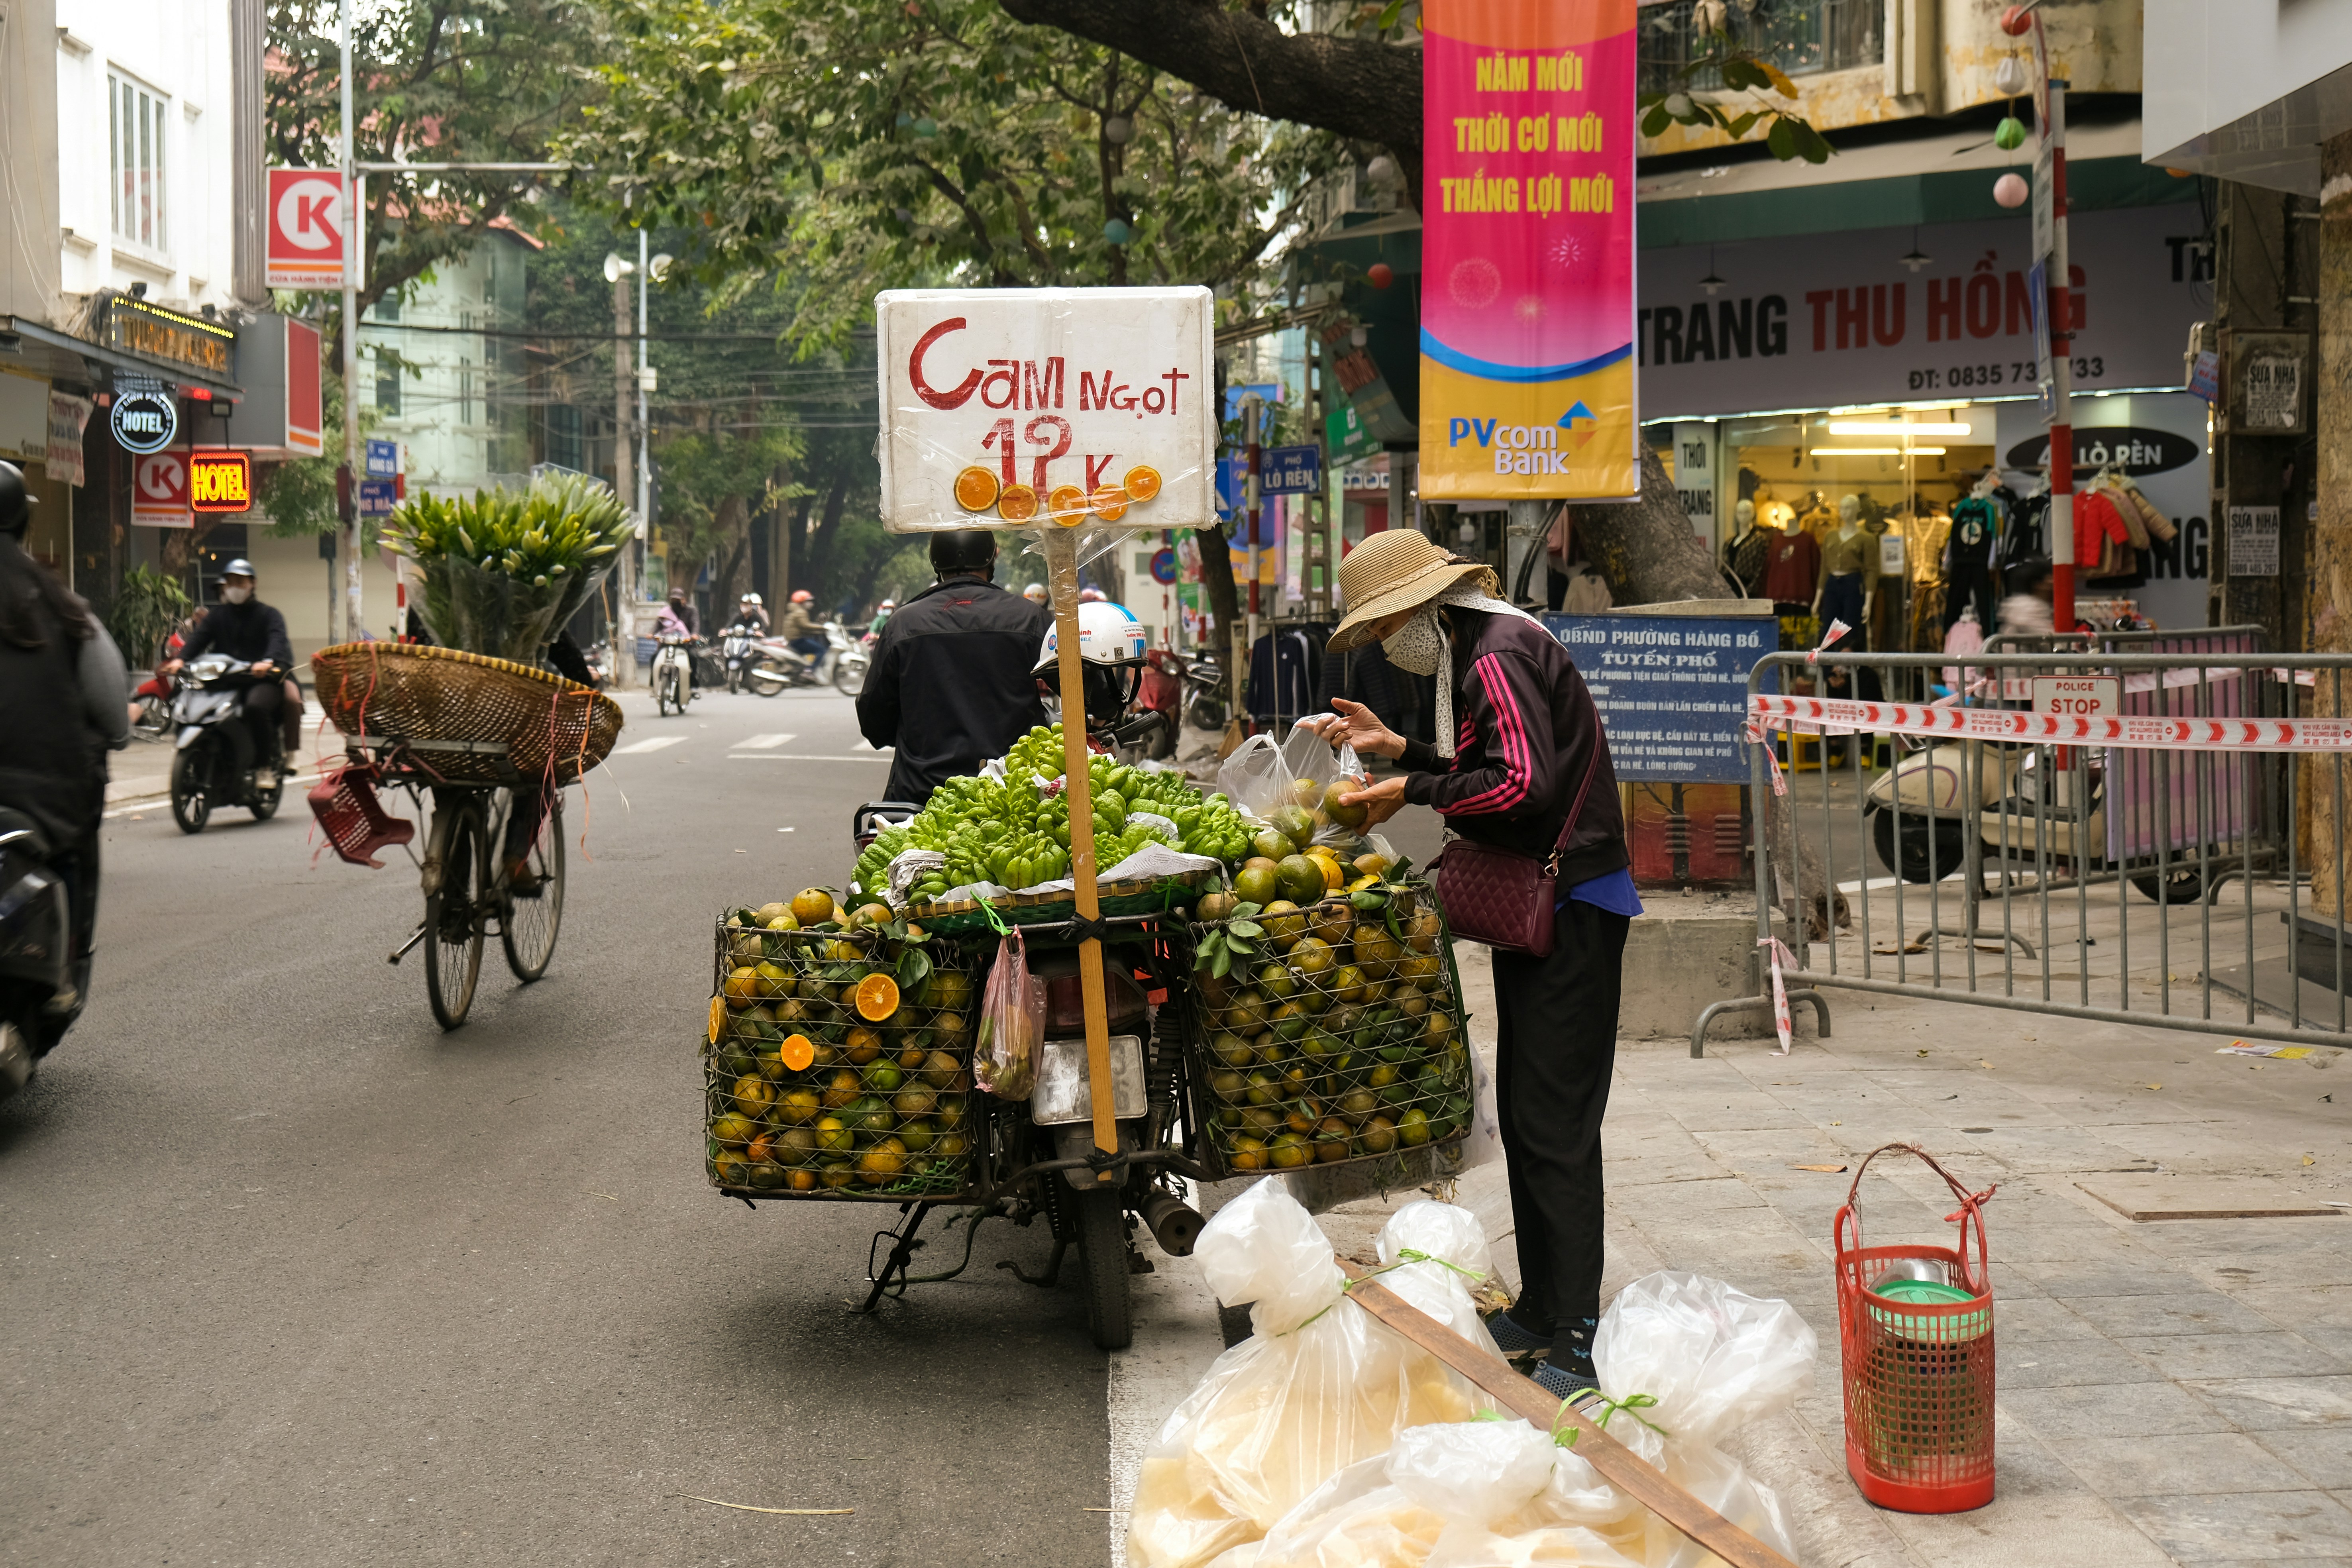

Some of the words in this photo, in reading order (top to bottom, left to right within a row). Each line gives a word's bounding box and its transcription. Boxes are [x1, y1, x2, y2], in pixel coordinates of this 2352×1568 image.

[1476, 51, 1528, 91] NĂM
[1537, 51, 1582, 91] MỚI
[1454, 112, 1509, 152] THỜI
[1518, 112, 1549, 152] CƠ
[1557, 111, 1602, 152] MỚI
[1440, 168, 1519, 212] THẮNG
[1527, 173, 1561, 219] LỢI
[1570, 173, 1613, 213] MỚI
[1637, 294, 1787, 367] TRANG
[1806, 283, 1906, 352] THU
[1908, 369, 1940, 390] ĐT:
[1948, 364, 2002, 387] 0835
[122, 410, 164, 433] HOTEL
[1450, 418, 1557, 449] PVcom
[1285, 453, 1302, 465] PHỐ
[1494, 450, 1569, 475] Bank
[2079, 440, 2109, 465] LÒ
[2115, 439, 2162, 467] RÈN
[192, 463, 247, 501] HOTEL
[1086, 455, 1113, 495] K
[1266, 468, 1282, 488] LÒ
[1286, 466, 1313, 487] RÈN
[1612, 628, 1680, 646] PHƯỜNG
[1685, 630, 1731, 647] HÀNG
[1602, 649, 1670, 666] TUYẾN
[1676, 651, 1717, 667] PHỐ
[2056, 682, 2094, 691] POLICE
[2051, 699, 2101, 714] STOP
